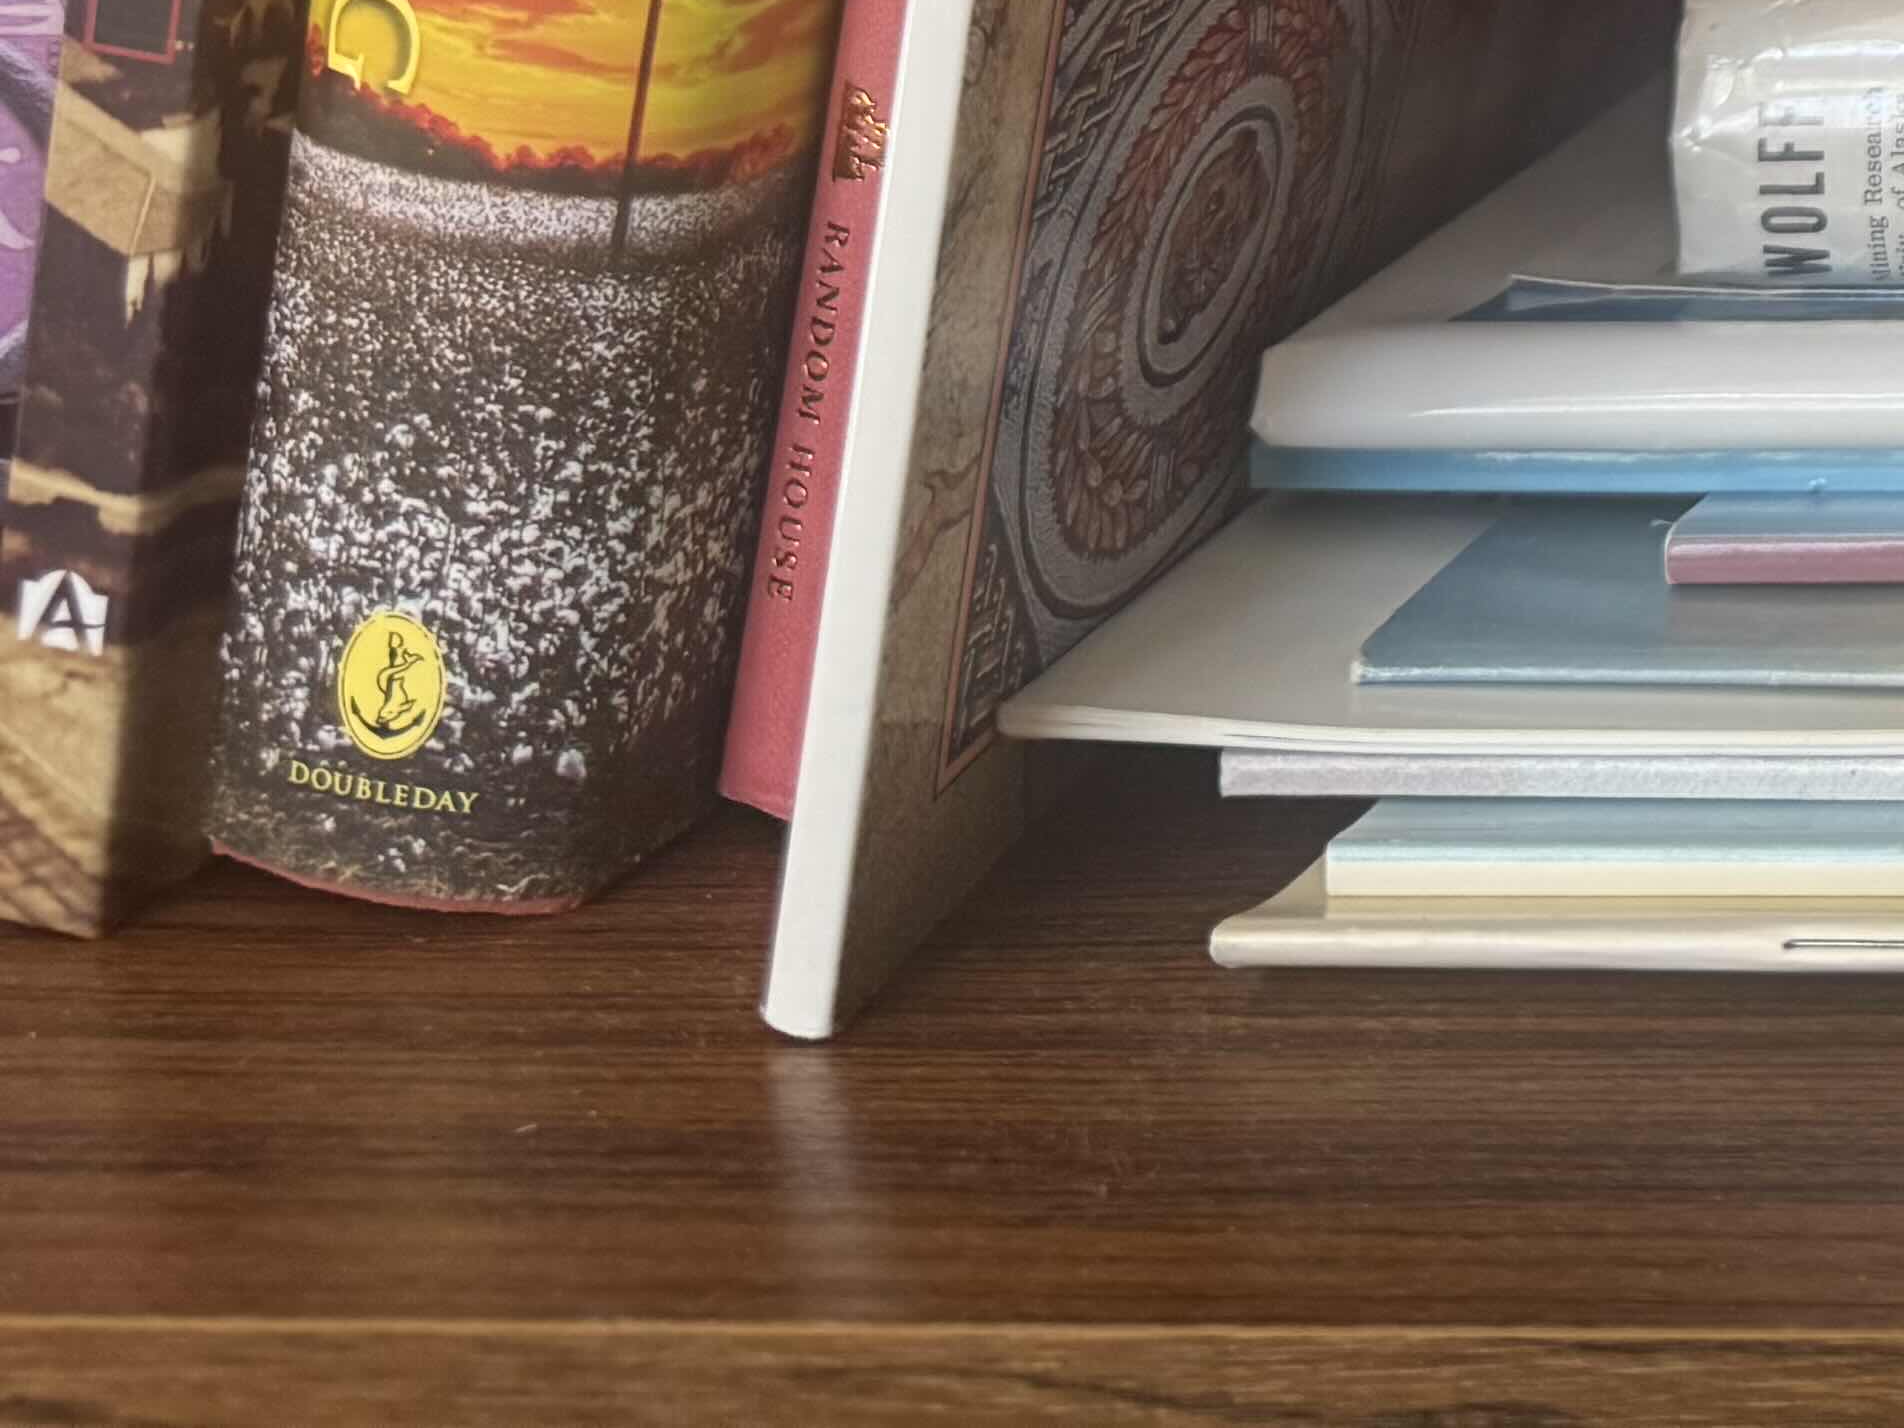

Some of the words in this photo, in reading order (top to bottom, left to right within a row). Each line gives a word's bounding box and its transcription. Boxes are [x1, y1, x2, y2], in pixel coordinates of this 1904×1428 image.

[1757, 101, 1832, 279] WOLFF
[799, 220, 851, 426] RANDOM
[766, 442, 814, 604] HOUSE
[288, 760, 480, 815] DOUBLEDAY
